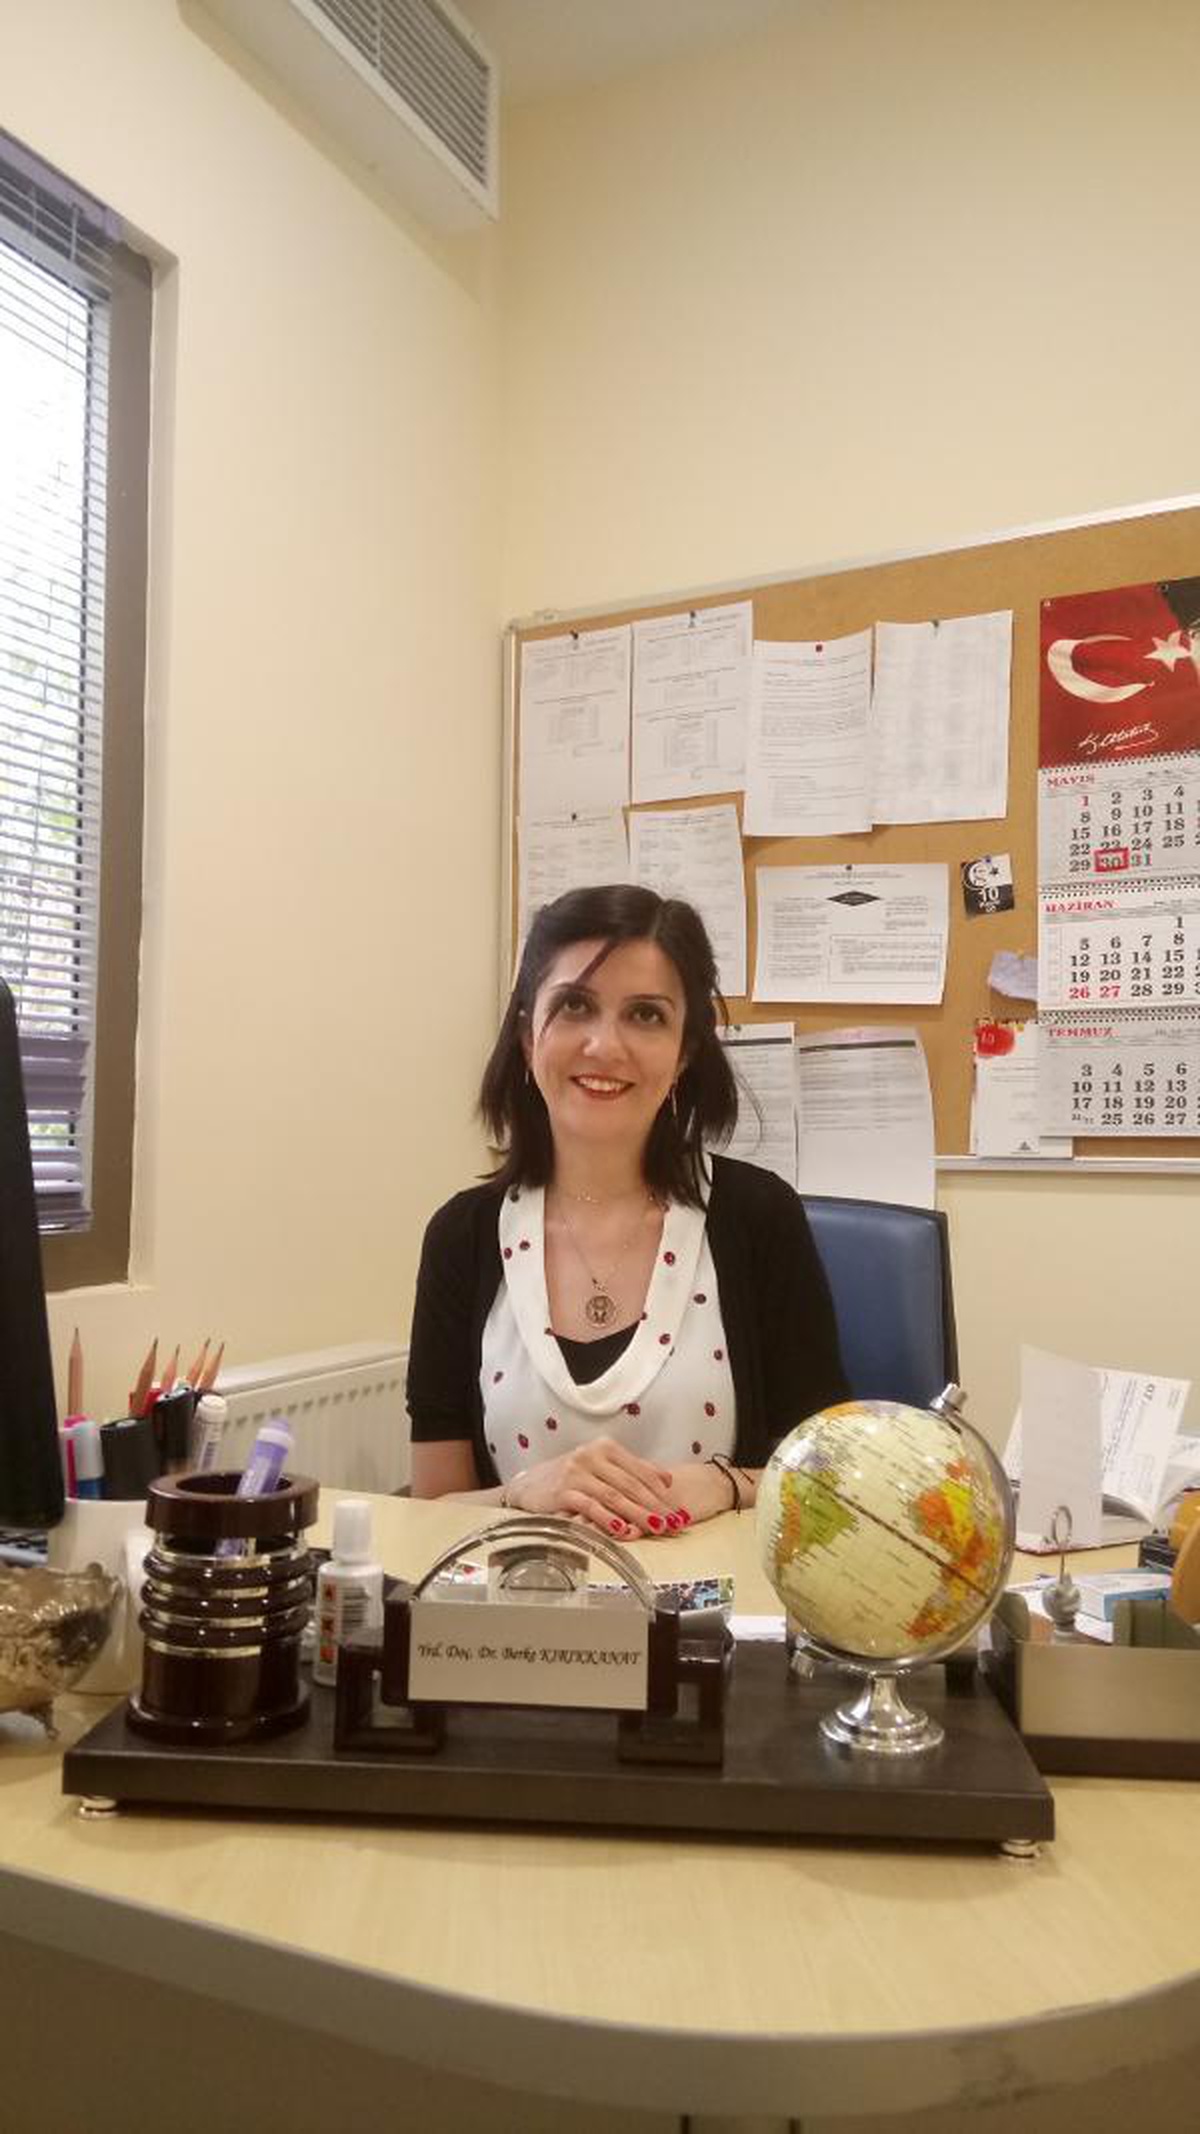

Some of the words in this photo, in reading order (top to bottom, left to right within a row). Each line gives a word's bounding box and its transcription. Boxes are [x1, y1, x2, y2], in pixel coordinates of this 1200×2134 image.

[1082, 795, 1089, 807] 1
[1111, 791, 1122, 805] 2
[1142, 789, 1153, 801] 3
[1173, 785, 1184, 797] 4
[1080, 811, 1091, 823] 8
[1111, 807, 1122, 821] 9
[1133, 805, 1153, 818] 10
[1165, 802, 1184, 815] 11
[1071, 827, 1091, 841] 15
[1102, 824, 1122, 837] 16
[1133, 821, 1153, 834] 17
[1165, 818, 1185, 831] 18
[1069, 843, 1091, 857] 22
[1131, 837, 1153, 851] 24
[1162, 834, 1185, 849] 25
[1069, 860, 1091, 873] 29
[1100, 856, 1122, 869] 30
[1131, 854, 1153, 866] 31
[1176, 916, 1184, 929] 1
[1080, 938, 1090, 951] 5
[1110, 936, 1121, 949] 6
[1141, 934, 1152, 947] 7
[1173, 933, 1185, 946] 8
[1070, 954, 1090, 967] 12
[1101, 953, 1121, 966] 13
[1133, 951, 1152, 964] 14
[1164, 950, 1185, 962] 15
[1070, 971, 1090, 983] 19
[1100, 969, 1121, 981] 20
[1130, 967, 1151, 980] 21
[1162, 965, 1185, 979] 22
[1069, 985, 1090, 999] 26
[1100, 985, 1121, 998] 27
[1130, 984, 1153, 997] 28
[1162, 983, 1185, 996] 29
[1081, 1063, 1093, 1077] 3
[1111, 1063, 1123, 1077] 4
[1143, 1063, 1155, 1076] 5
[1175, 1062, 1188, 1076] 6
[1071, 1081, 1093, 1093] 10
[1103, 1081, 1122, 1093] 11
[1134, 1080, 1155, 1092] 12
[1166, 1079, 1187, 1092] 13
[1071, 1097, 1093, 1110] 17
[1103, 1097, 1123, 1109] 18
[1134, 1096, 1155, 1109] 19
[1164, 1095, 1187, 1109] 20
[1101, 1113, 1123, 1125] 25
[1132, 1113, 1155, 1125] 26
[1164, 1113, 1187, 1125] 27
[479, 1645, 498, 1659] Dr.
